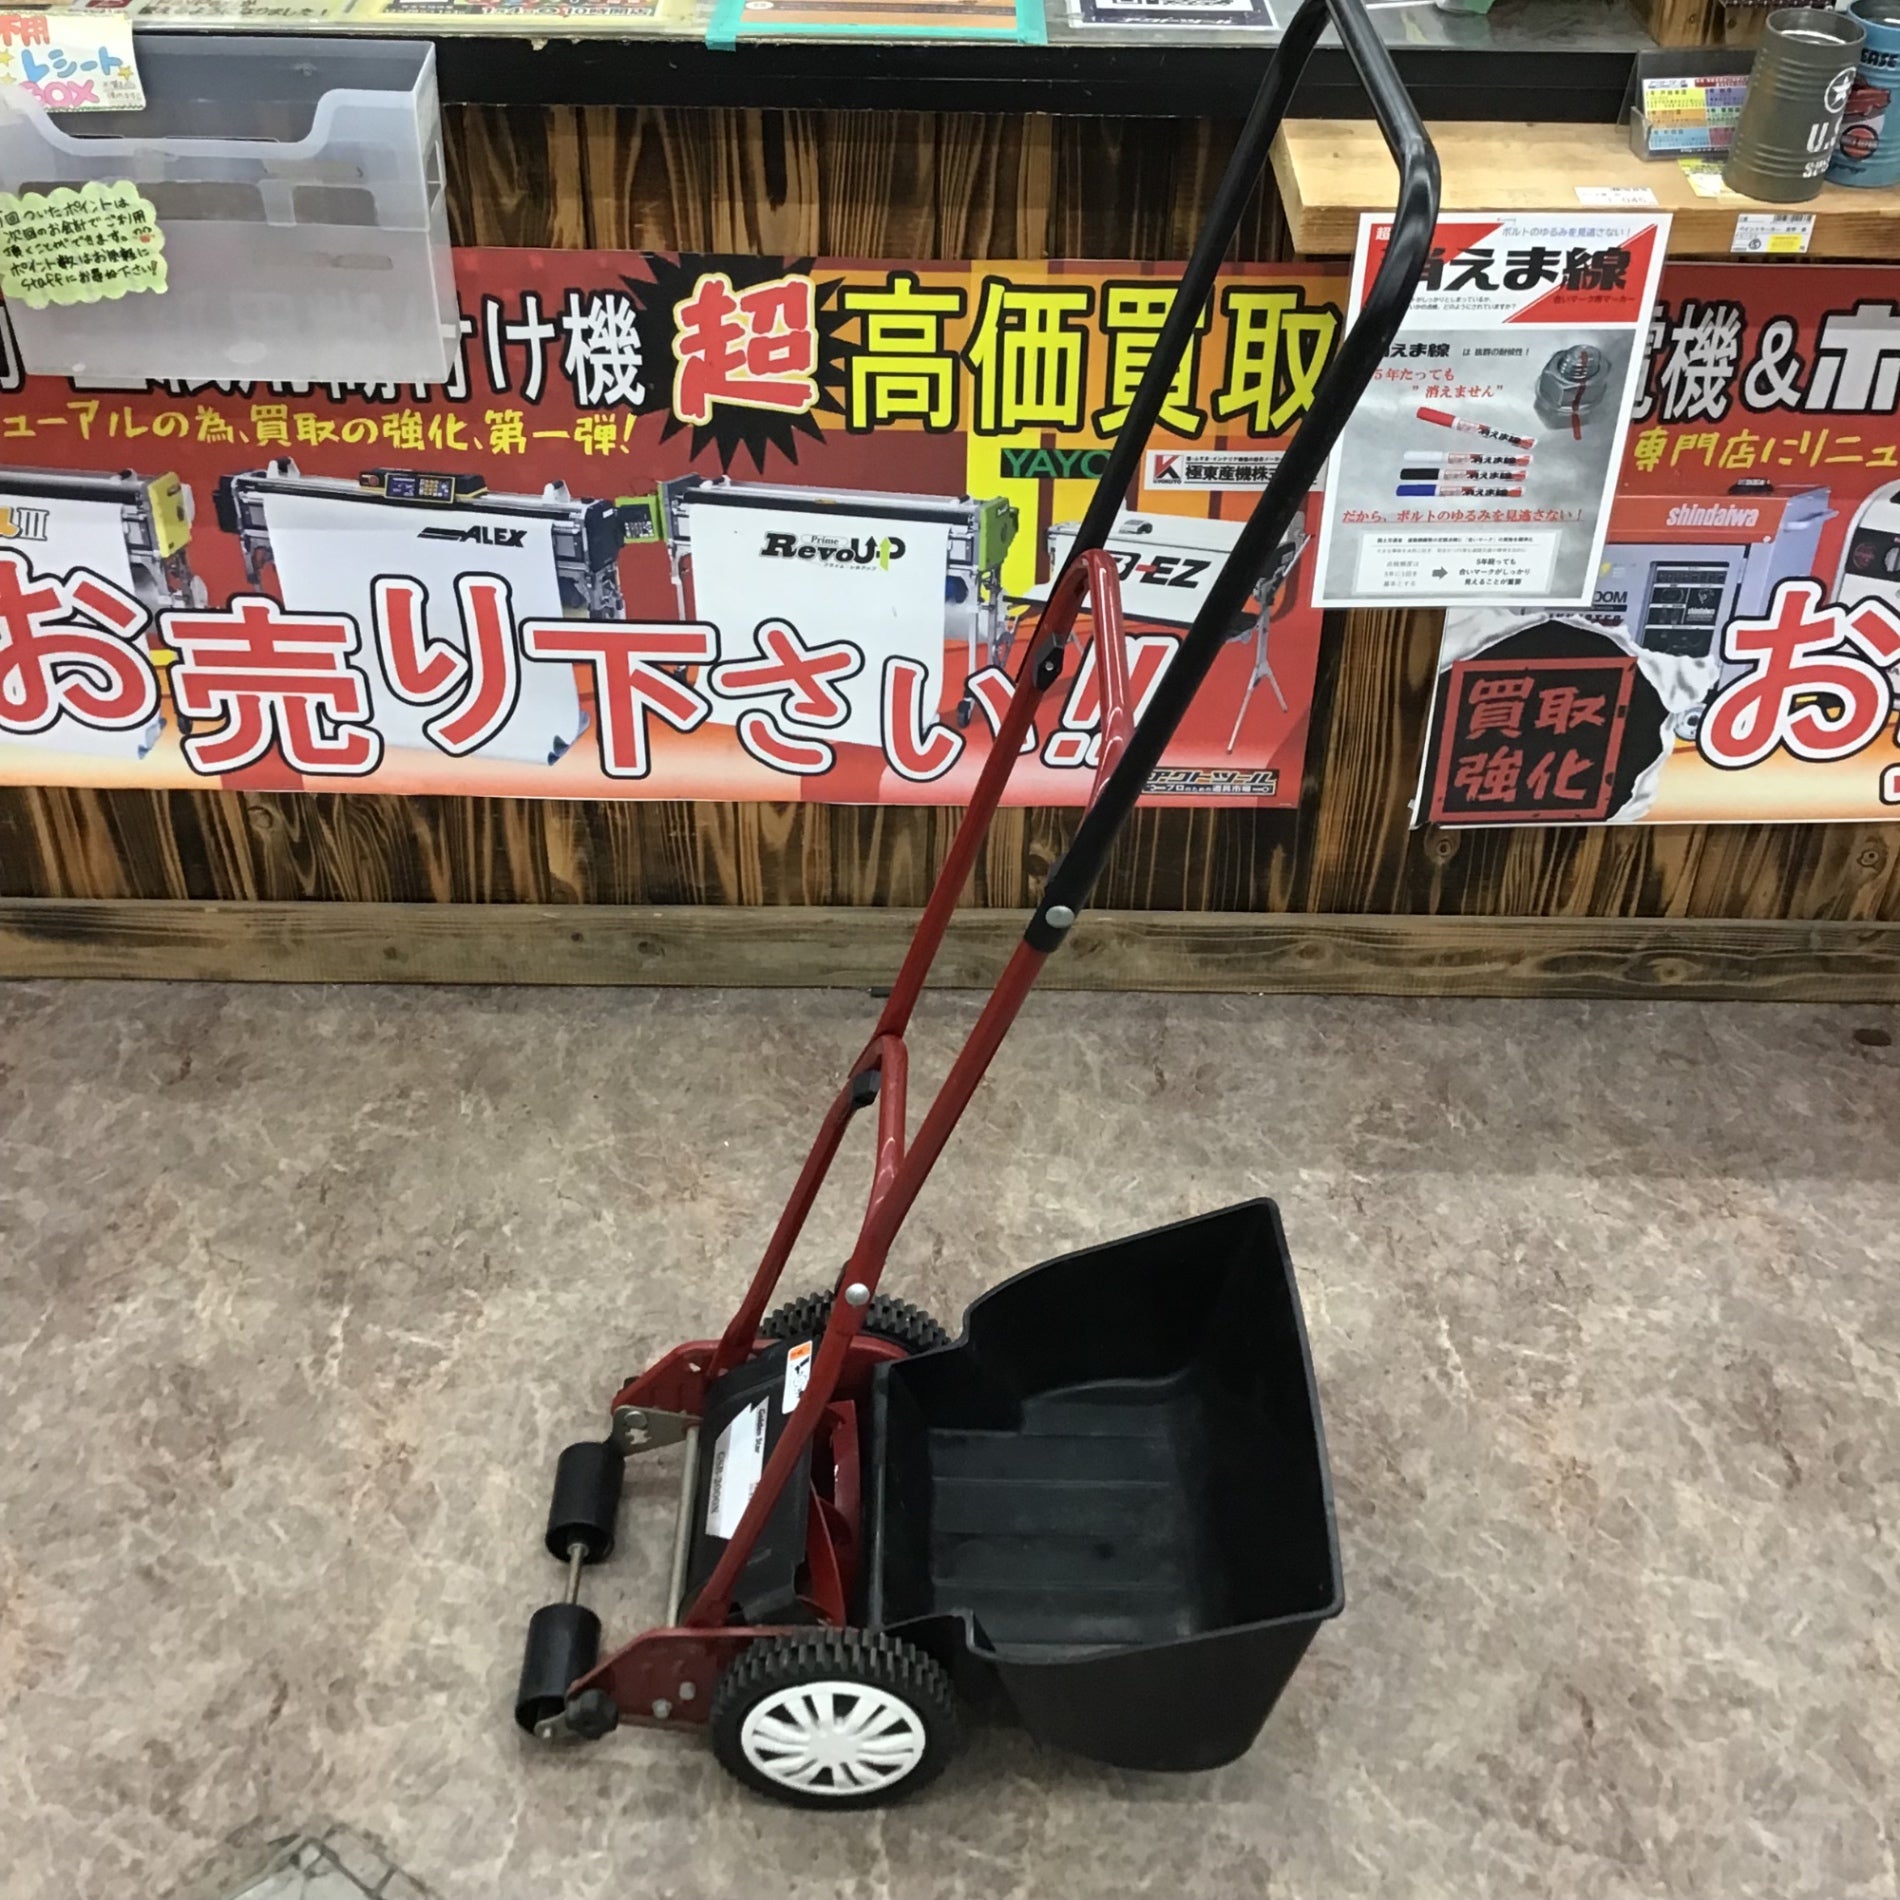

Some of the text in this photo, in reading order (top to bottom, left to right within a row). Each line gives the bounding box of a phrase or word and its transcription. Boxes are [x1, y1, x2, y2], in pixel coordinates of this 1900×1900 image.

[21, 46, 123, 82] レシート
[0, 198, 129, 229] 回ついたポイントは
[674, 275, 818, 425] 超
[843, 278, 1338, 433] 高価買取
[1666, 503, 1760, 527] shindaiwa
[452, 525, 528, 548] ALEX
[811, 535, 840, 546] Prime
[1467, 677, 1606, 741] 買取
[1455, 746, 1596, 803] 強化
